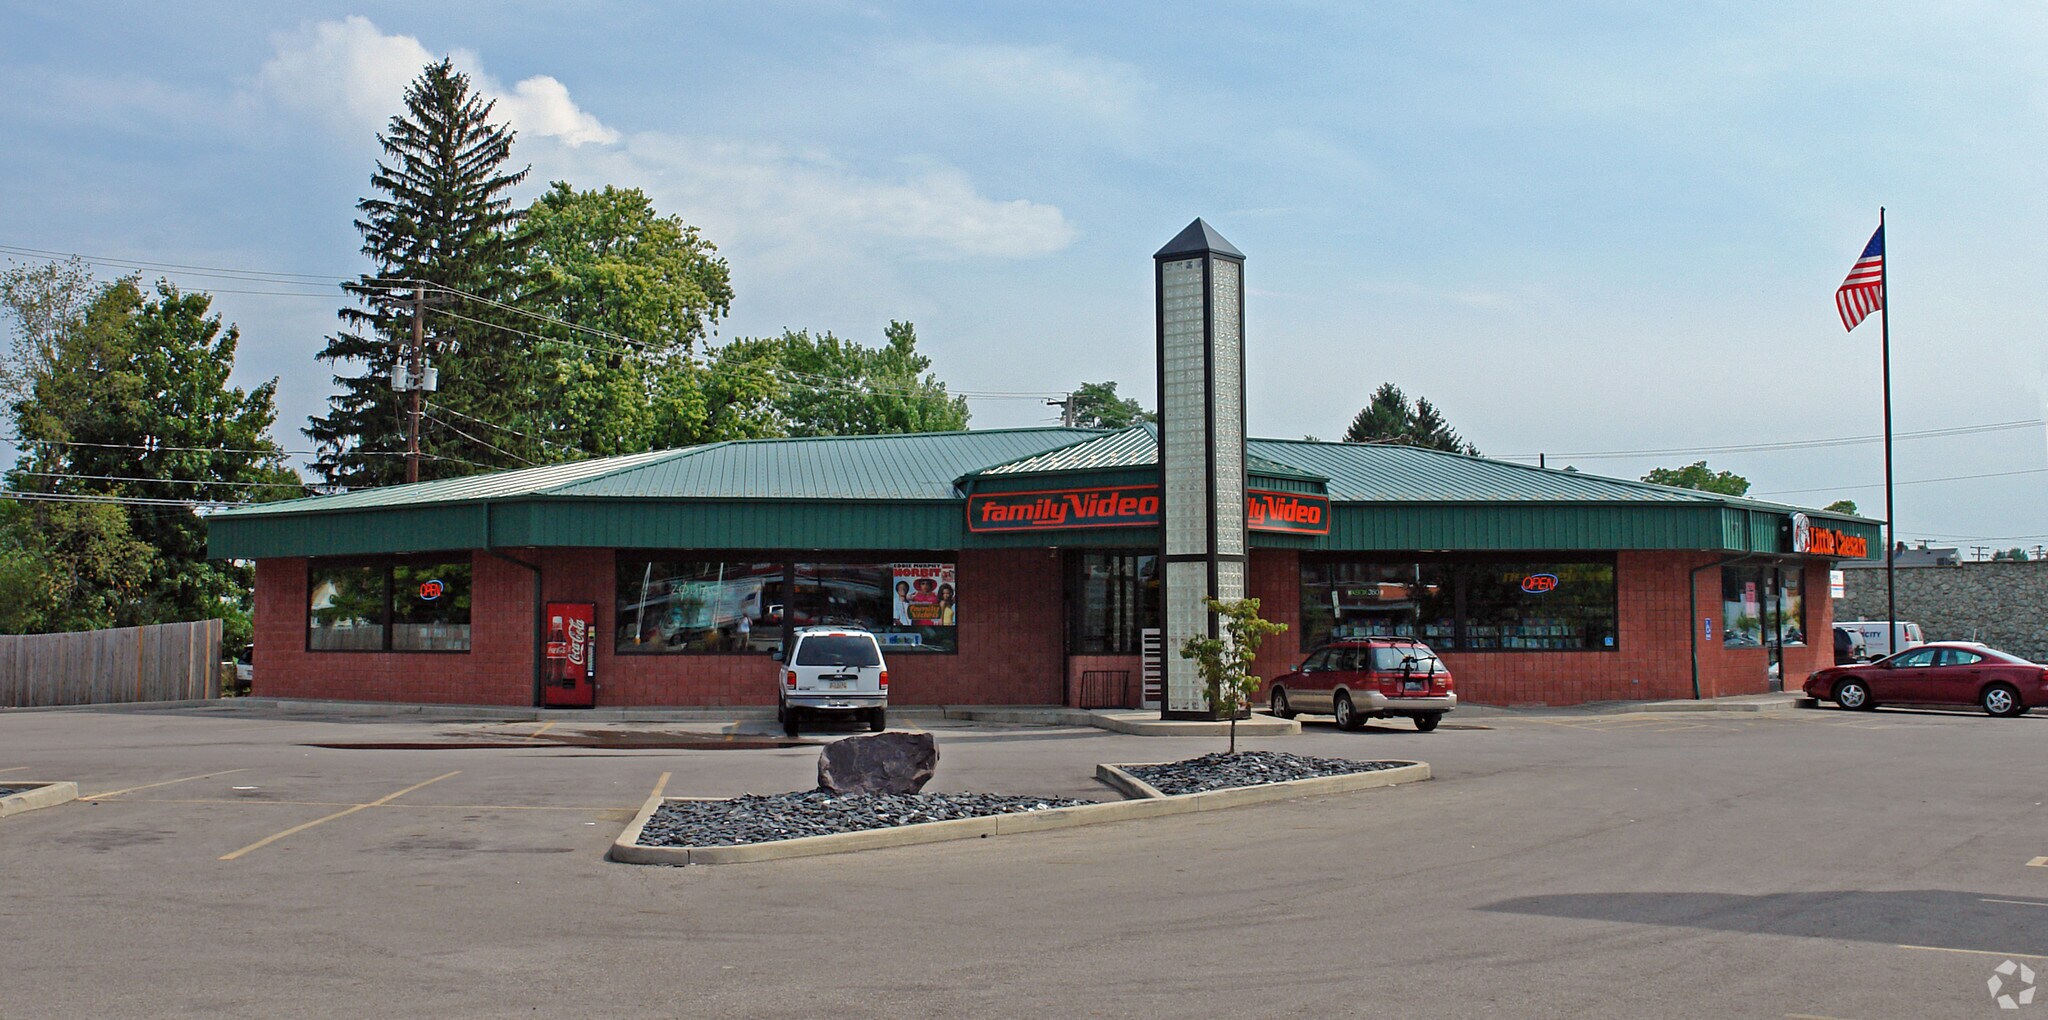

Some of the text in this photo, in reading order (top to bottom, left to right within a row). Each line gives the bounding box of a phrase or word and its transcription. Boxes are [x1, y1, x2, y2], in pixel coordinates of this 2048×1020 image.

[1809, 527, 1835, 555] Little
[894, 568, 941, 578] NORBIT
[419, 583, 441, 597] OPEN
[1522, 576, 1556, 590] OPEN
